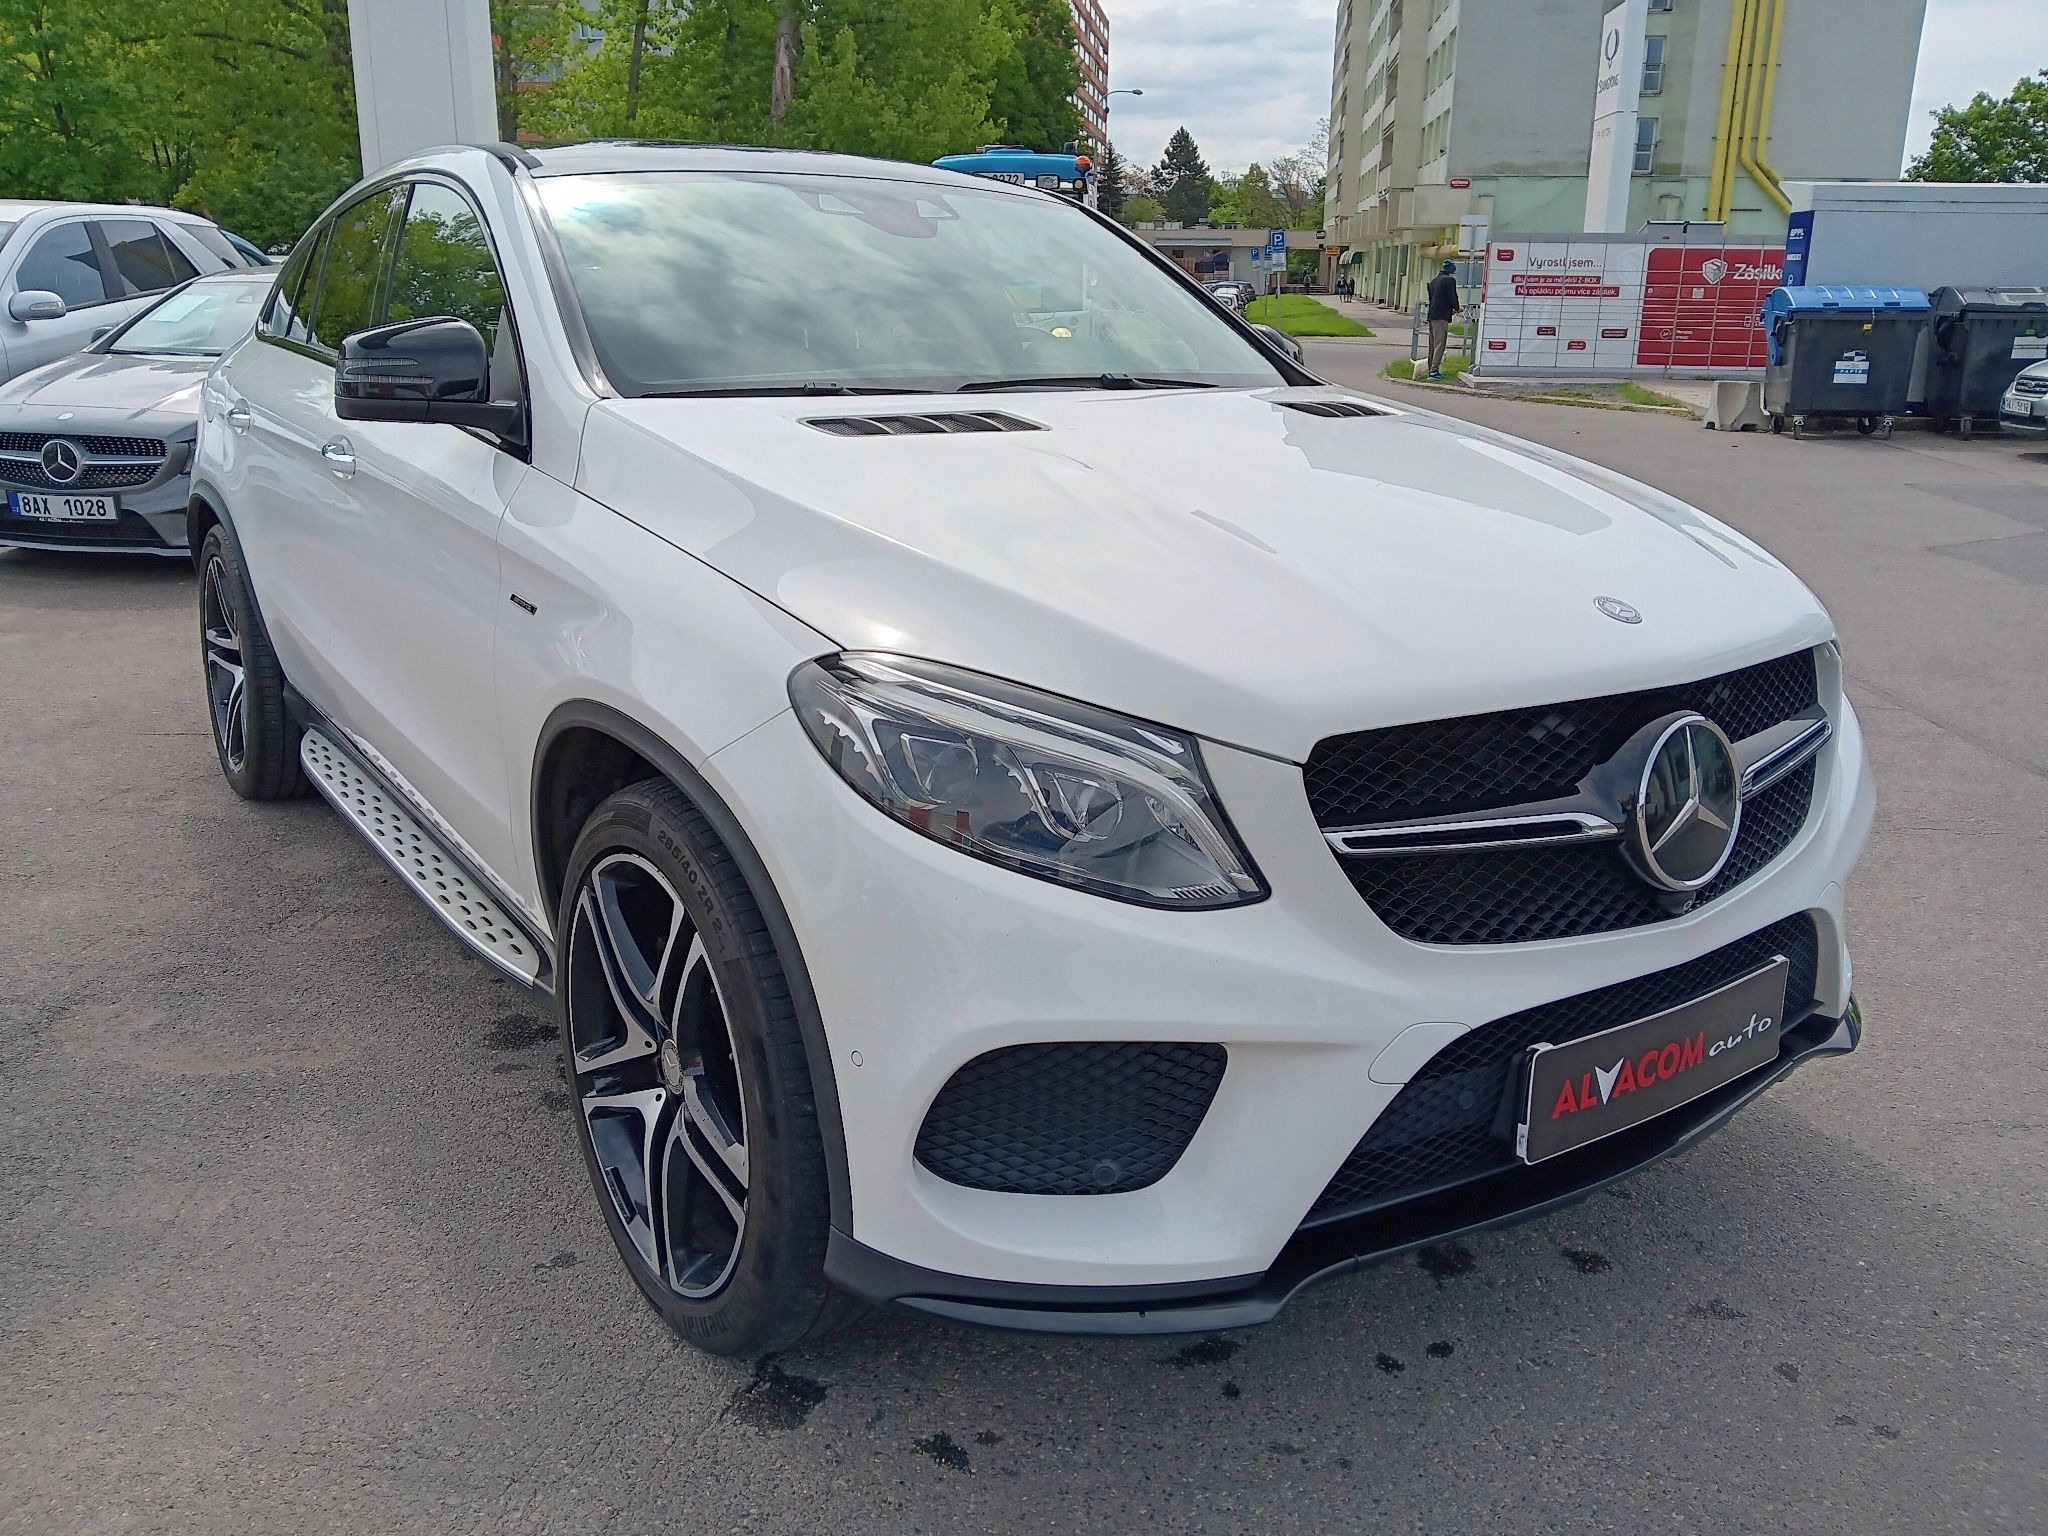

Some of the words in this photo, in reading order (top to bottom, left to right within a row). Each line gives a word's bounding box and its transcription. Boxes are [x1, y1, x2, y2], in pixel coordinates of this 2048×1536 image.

[1529, 257, 1567, 269] Vyrostl
[1567, 257, 1602, 269] jsem...
[21, 496, 51, 515] 8AX
[64, 498, 107, 517] 1028
[1552, 1032, 1704, 1119] ALVACOM
[1709, 1013, 1772, 1057] auto
